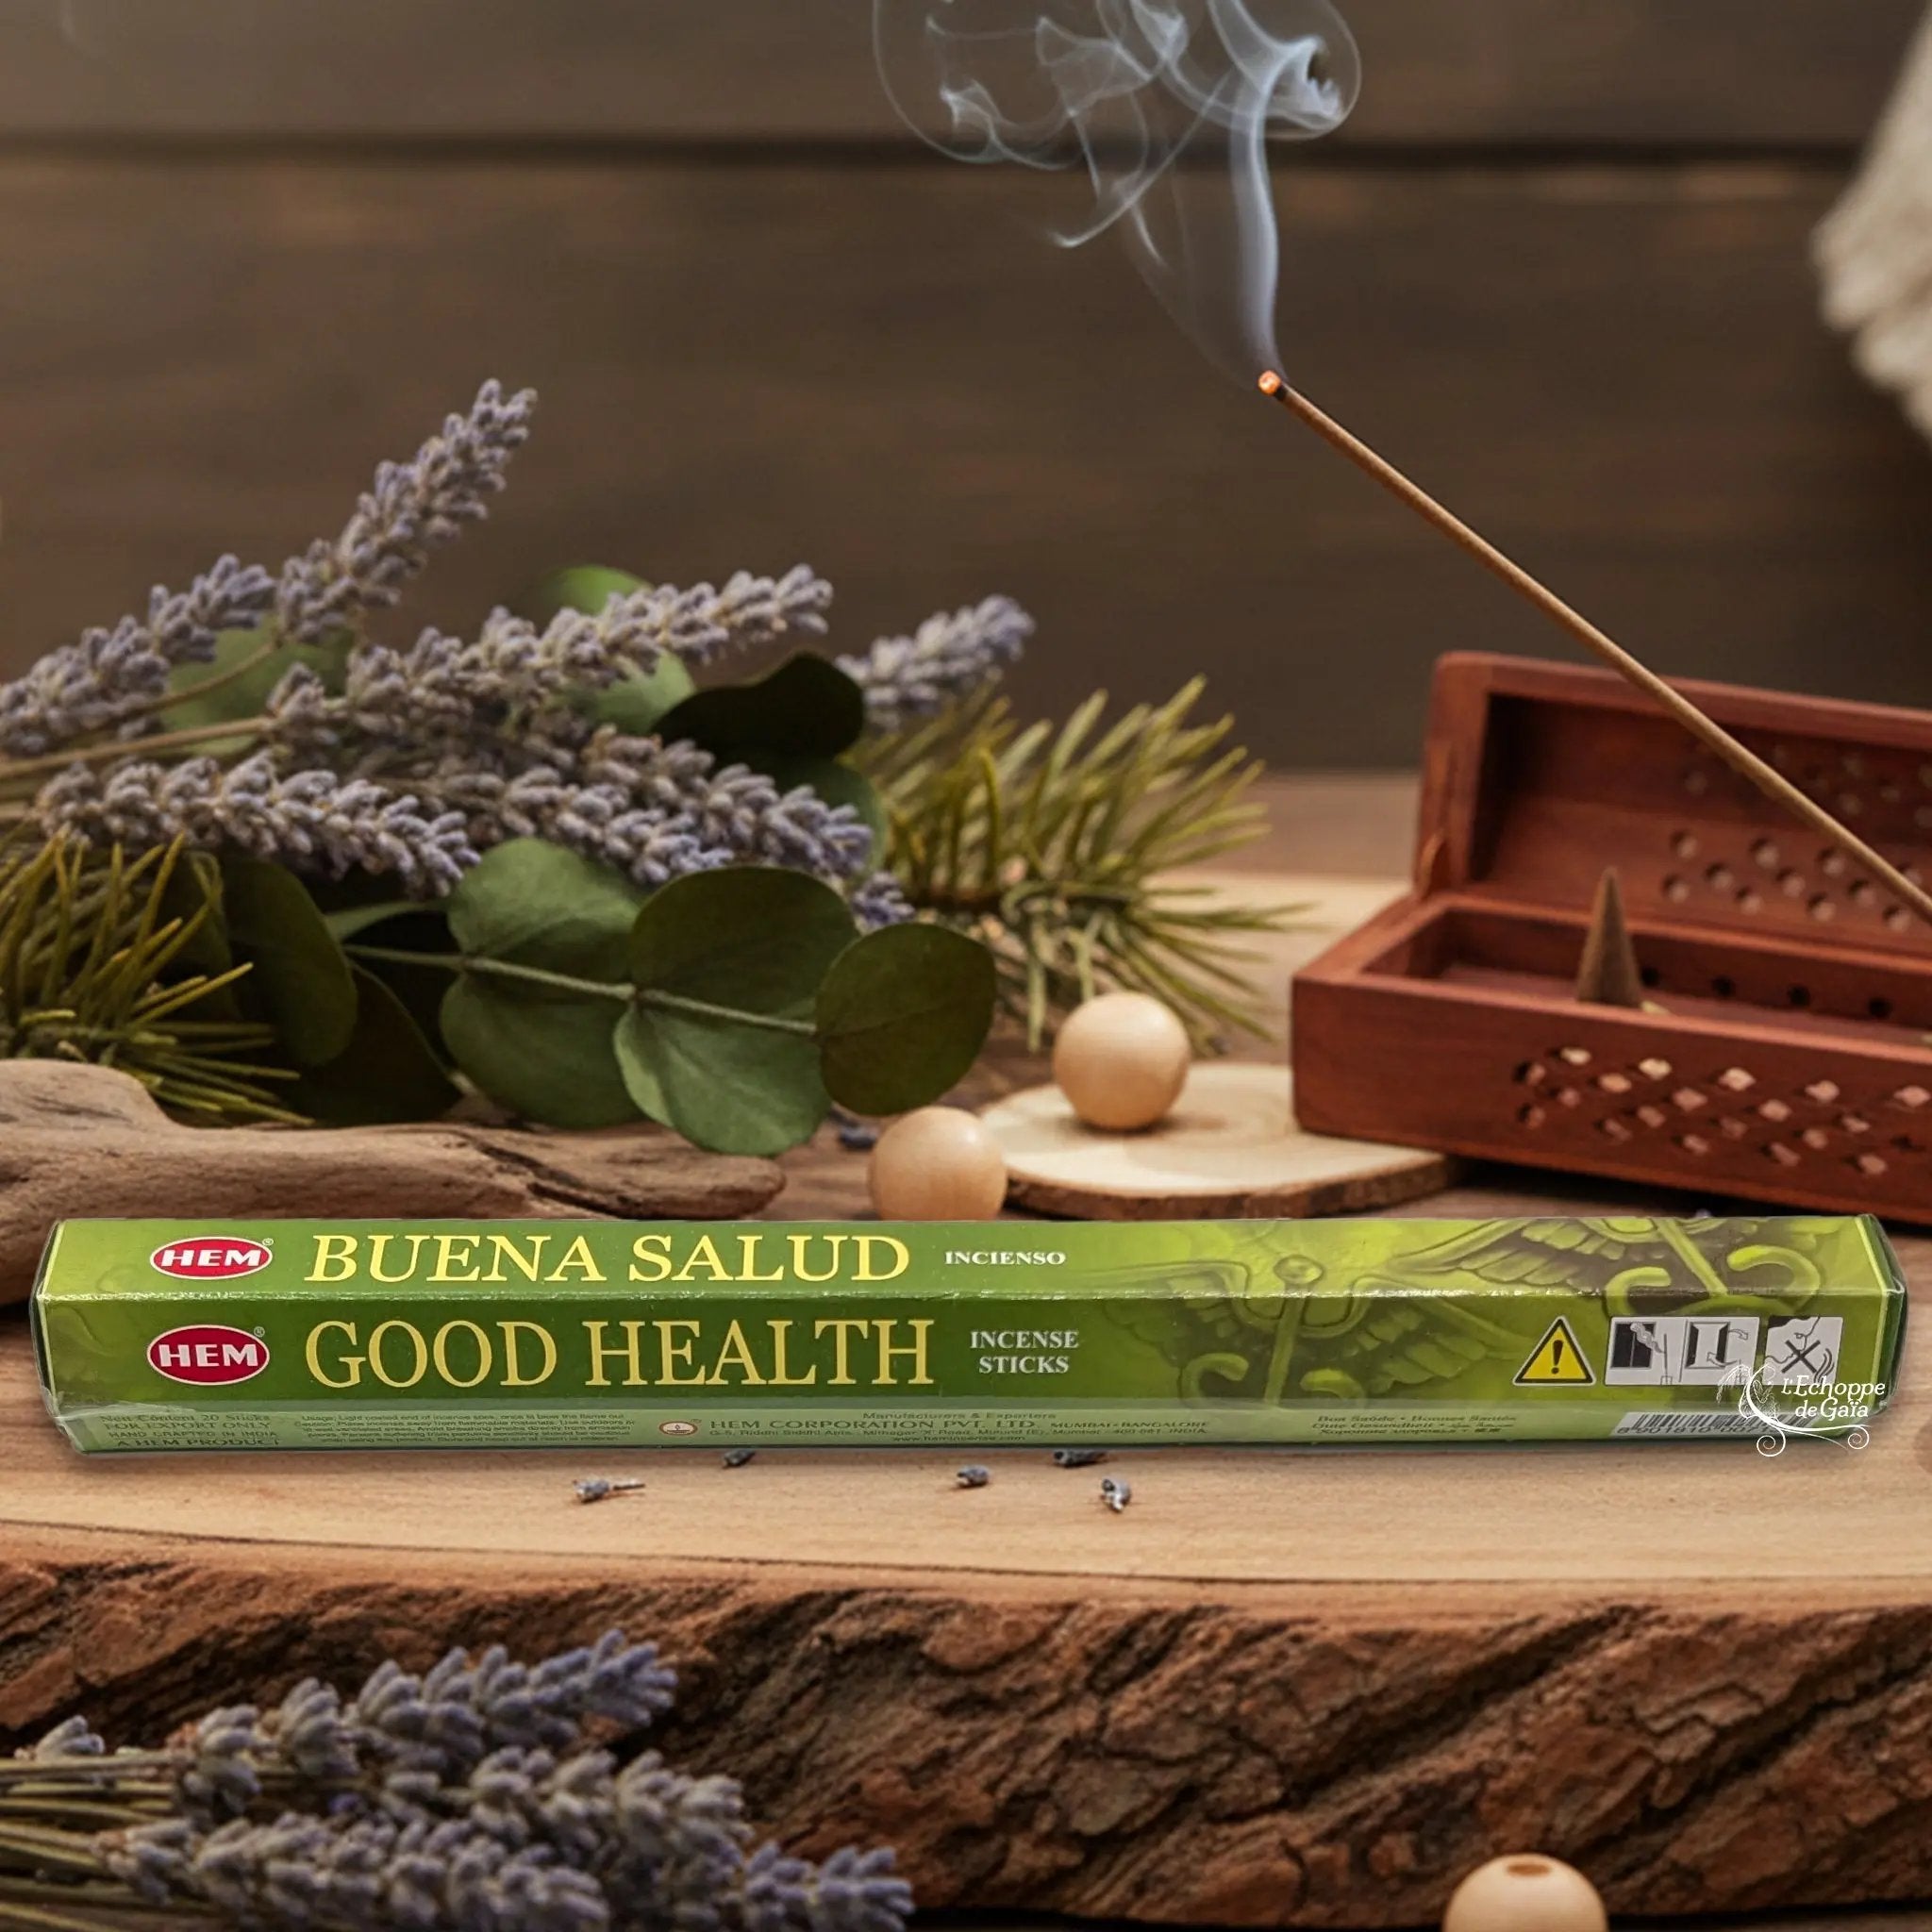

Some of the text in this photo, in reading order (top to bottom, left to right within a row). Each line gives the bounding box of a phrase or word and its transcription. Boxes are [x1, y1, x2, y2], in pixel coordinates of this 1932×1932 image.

[160, 1249, 261, 1267] HEM
[304, 1234, 909, 1283] BUENA SALUD
[944, 1250, 1067, 1265] INCIENSO
[970, 1330, 1079, 1349] INCENSE
[158, 1343, 258, 1367] HEM
[305, 1319, 935, 1389] GOOD HEALTH
[978, 1356, 1070, 1374] STICKS
[710, 1421, 759, 1429] HEM
[769, 1420, 934, 1428] CORPORATION
